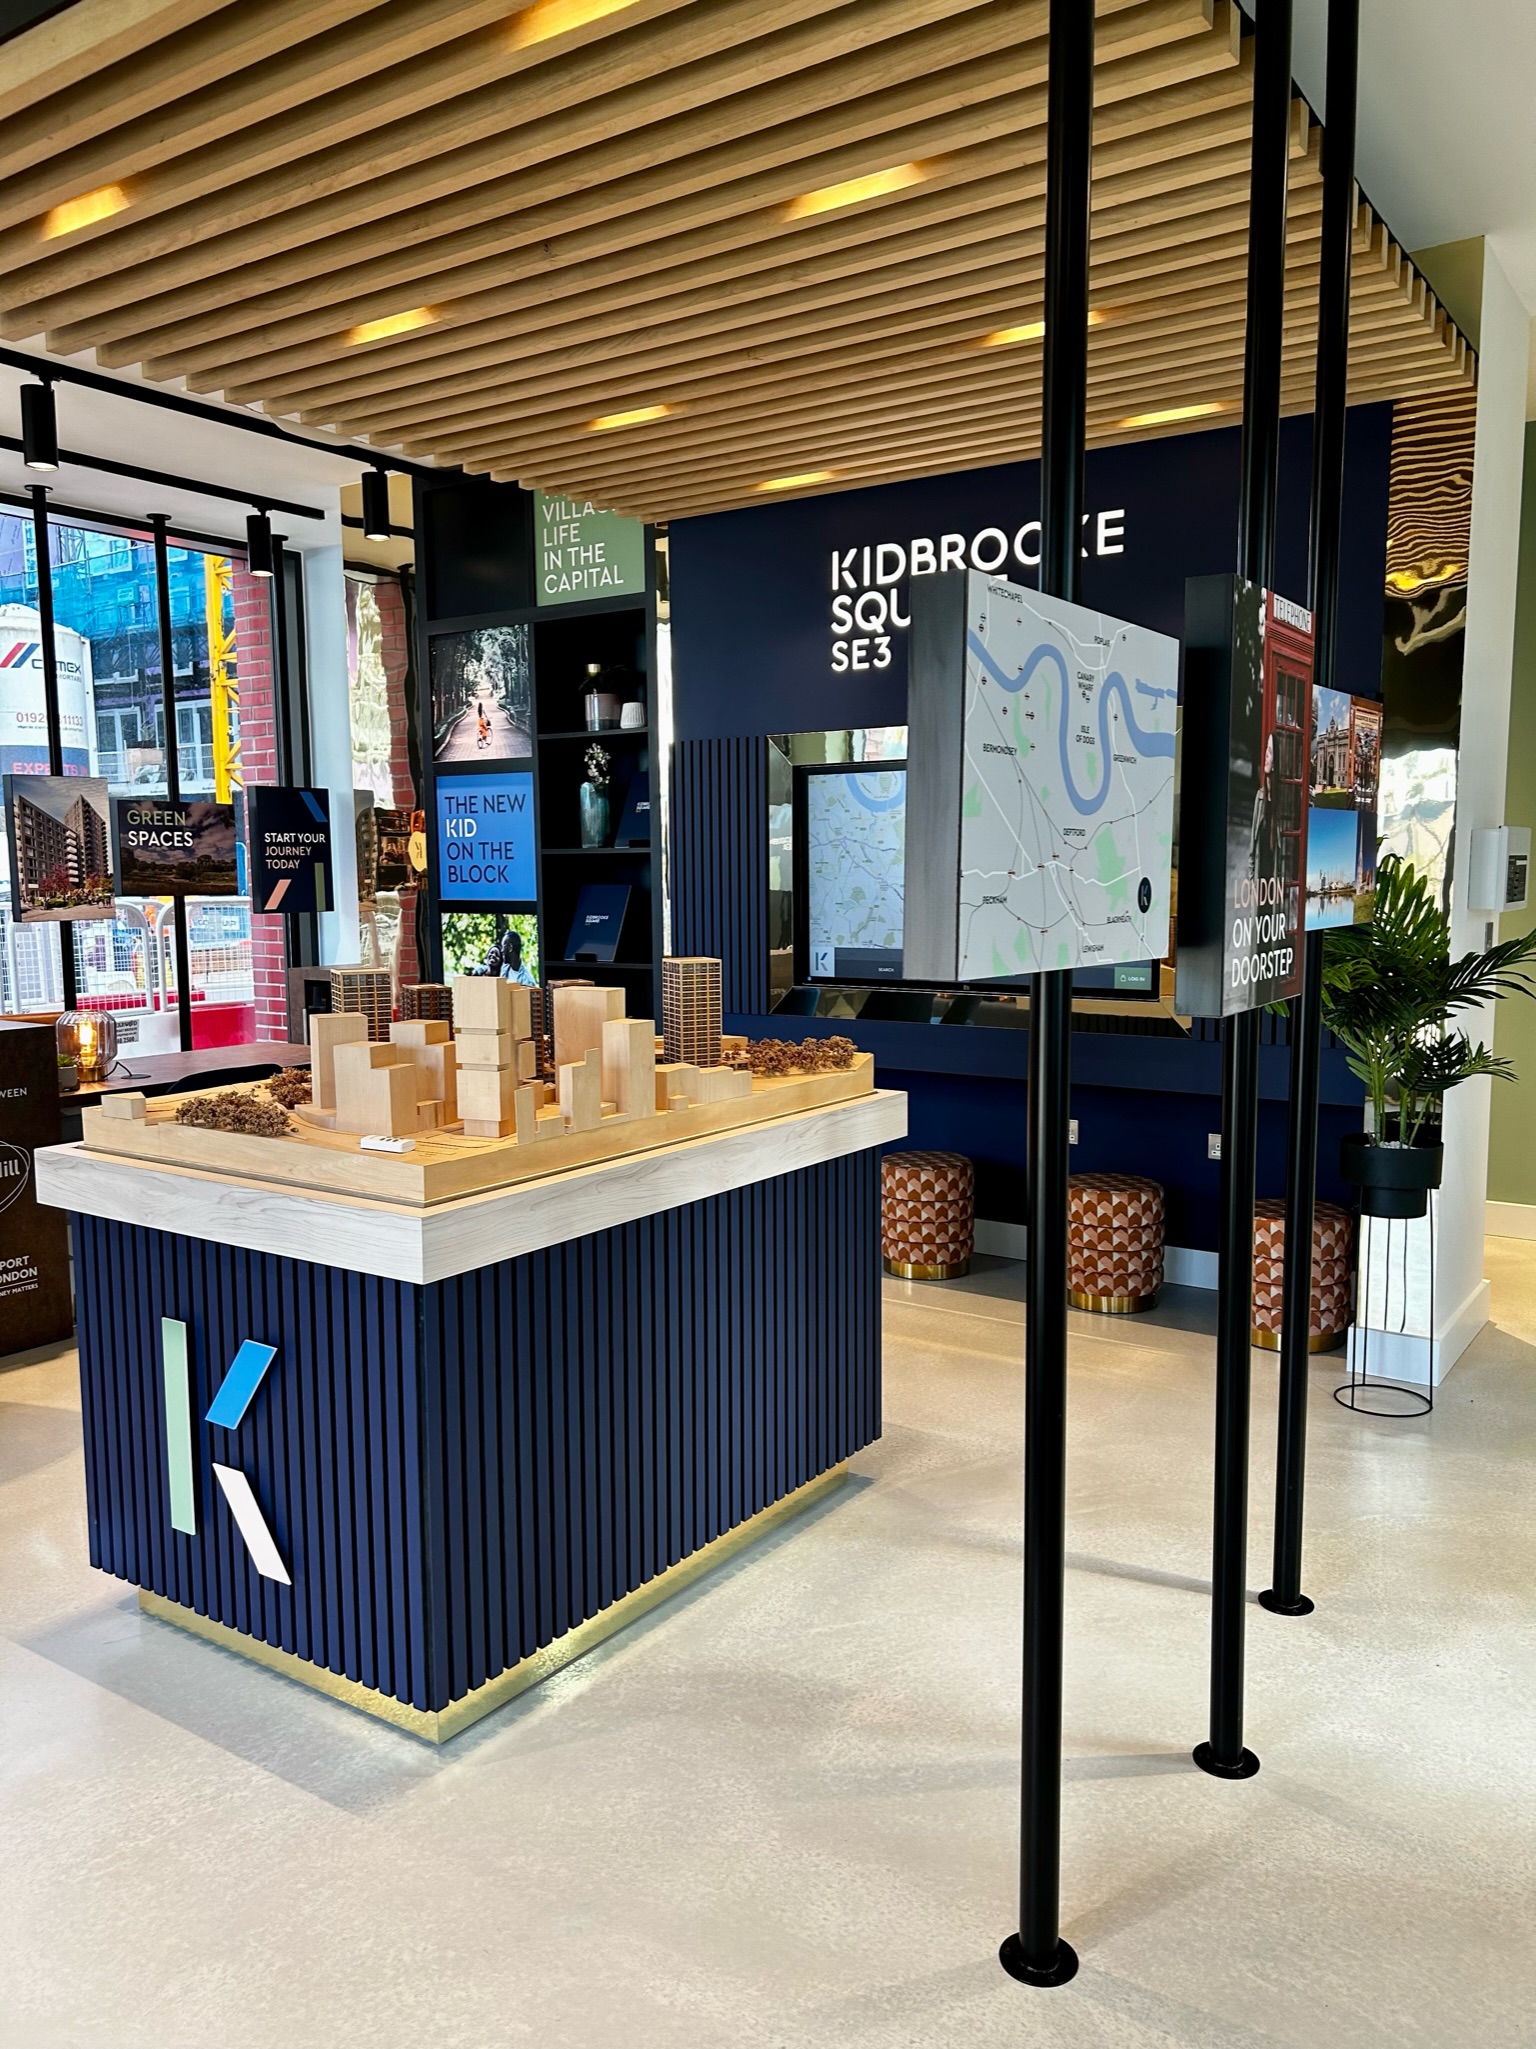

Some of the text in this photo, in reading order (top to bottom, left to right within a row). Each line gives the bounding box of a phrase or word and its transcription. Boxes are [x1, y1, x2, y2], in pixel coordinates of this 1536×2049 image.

[542, 501, 616, 522] VILLA
[543, 523, 581, 547] LIFE
[544, 542, 606, 571] IN THE
[831, 508, 1125, 591] KIDBROOE
[544, 564, 624, 594] CAPITAL
[987, 583, 1023, 604] WHITECHAPEL
[1275, 597, 1311, 632] TELEPHONE
[831, 635, 893, 672] SE3
[31, 658, 82, 675] CMEX
[1077, 671, 1095, 682] CANARY
[983, 743, 1018, 756] BERMONDSEY
[1083, 736, 1096, 745] DOGS
[1113, 754, 1138, 764] GREENWICH
[12, 762, 79, 777] EXPETS
[444, 793, 526, 815] THE NEW
[127, 809, 186, 826] GREEN
[446, 818, 477, 838] KID
[1063, 828, 1086, 837] DEPTFORD
[128, 830, 193, 847] SPACES
[264, 832, 326, 844] START YOUR
[265, 846, 312, 857] JOURNEY
[446, 842, 514, 861] ON THE
[266, 859, 301, 870] TODAY
[448, 864, 509, 884] BLOCK
[983, 896, 1007, 905] PECKHAM
[1234, 877, 1285, 909] LONDON
[1232, 912, 1286, 948] ON YOUR
[1231, 947, 1294, 988] DOORSTEP
[12, 1283, 39, 1294] MATTERS
